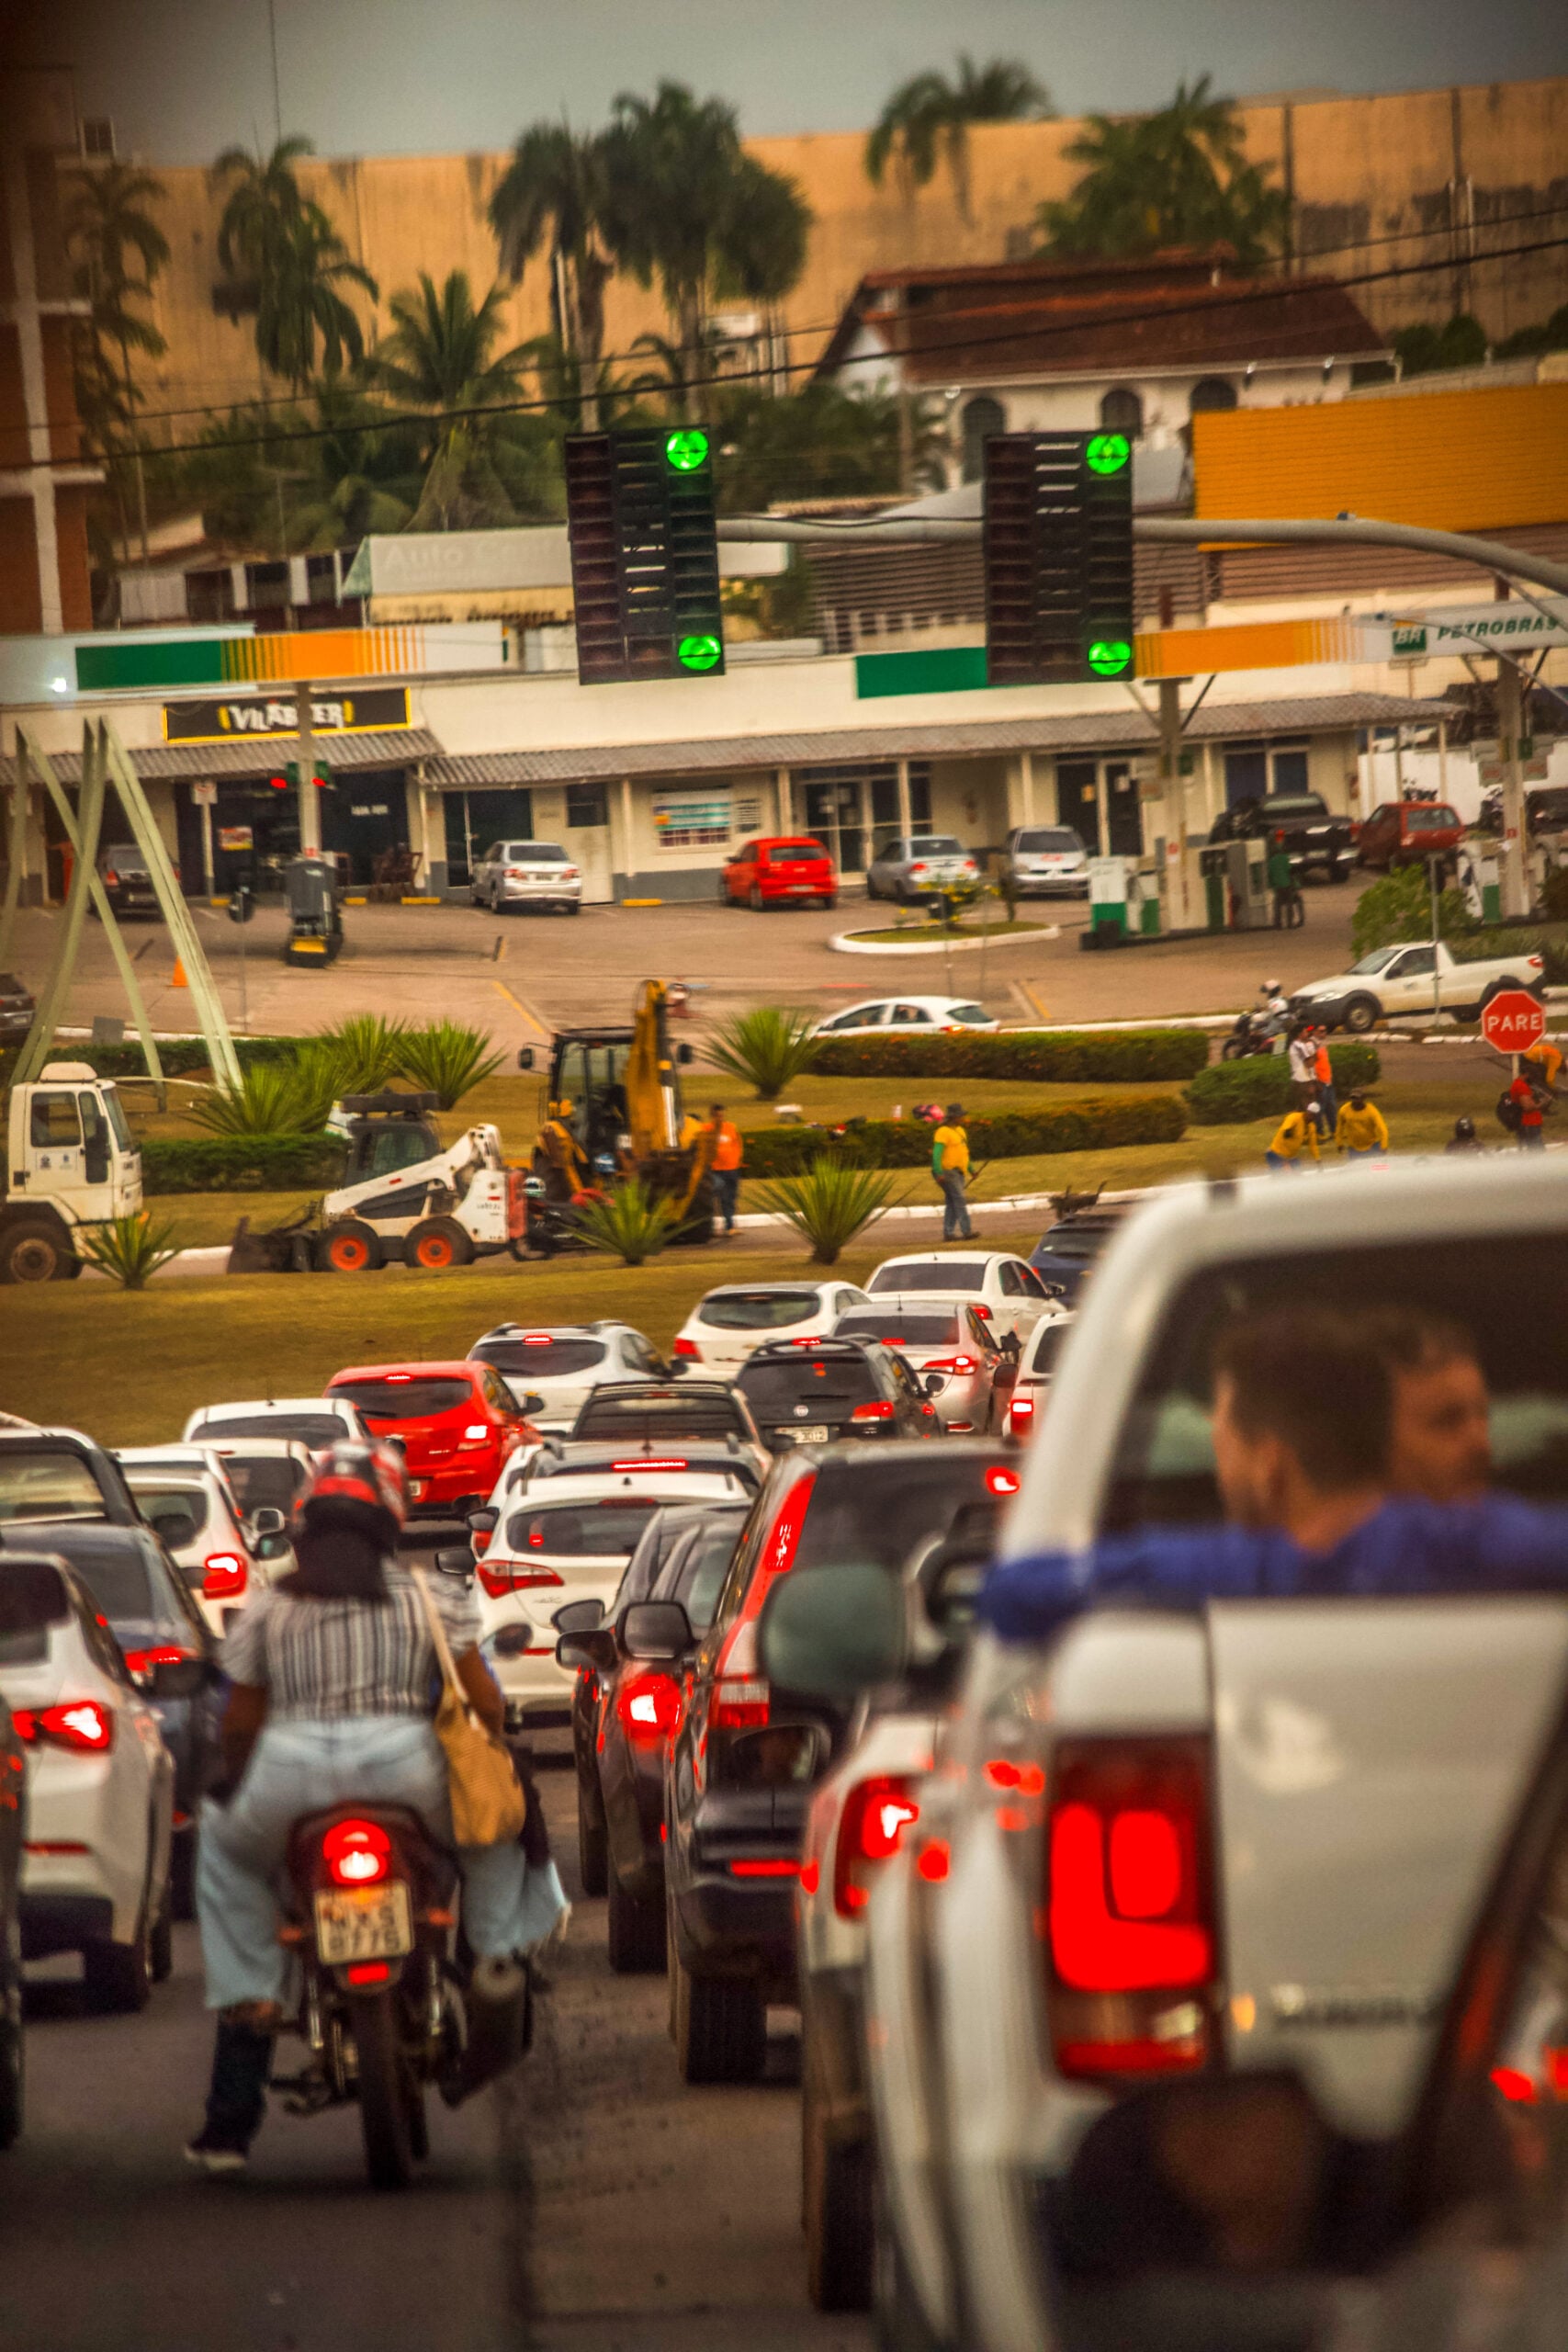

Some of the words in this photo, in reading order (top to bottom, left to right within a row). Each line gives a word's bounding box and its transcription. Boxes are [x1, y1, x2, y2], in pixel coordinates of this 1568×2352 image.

[383, 545, 465, 570] Auto
[1437, 615, 1560, 640] PETROBRAS
[230, 703, 345, 731] VILABER
[1487, 1013, 1542, 1033] PARE
